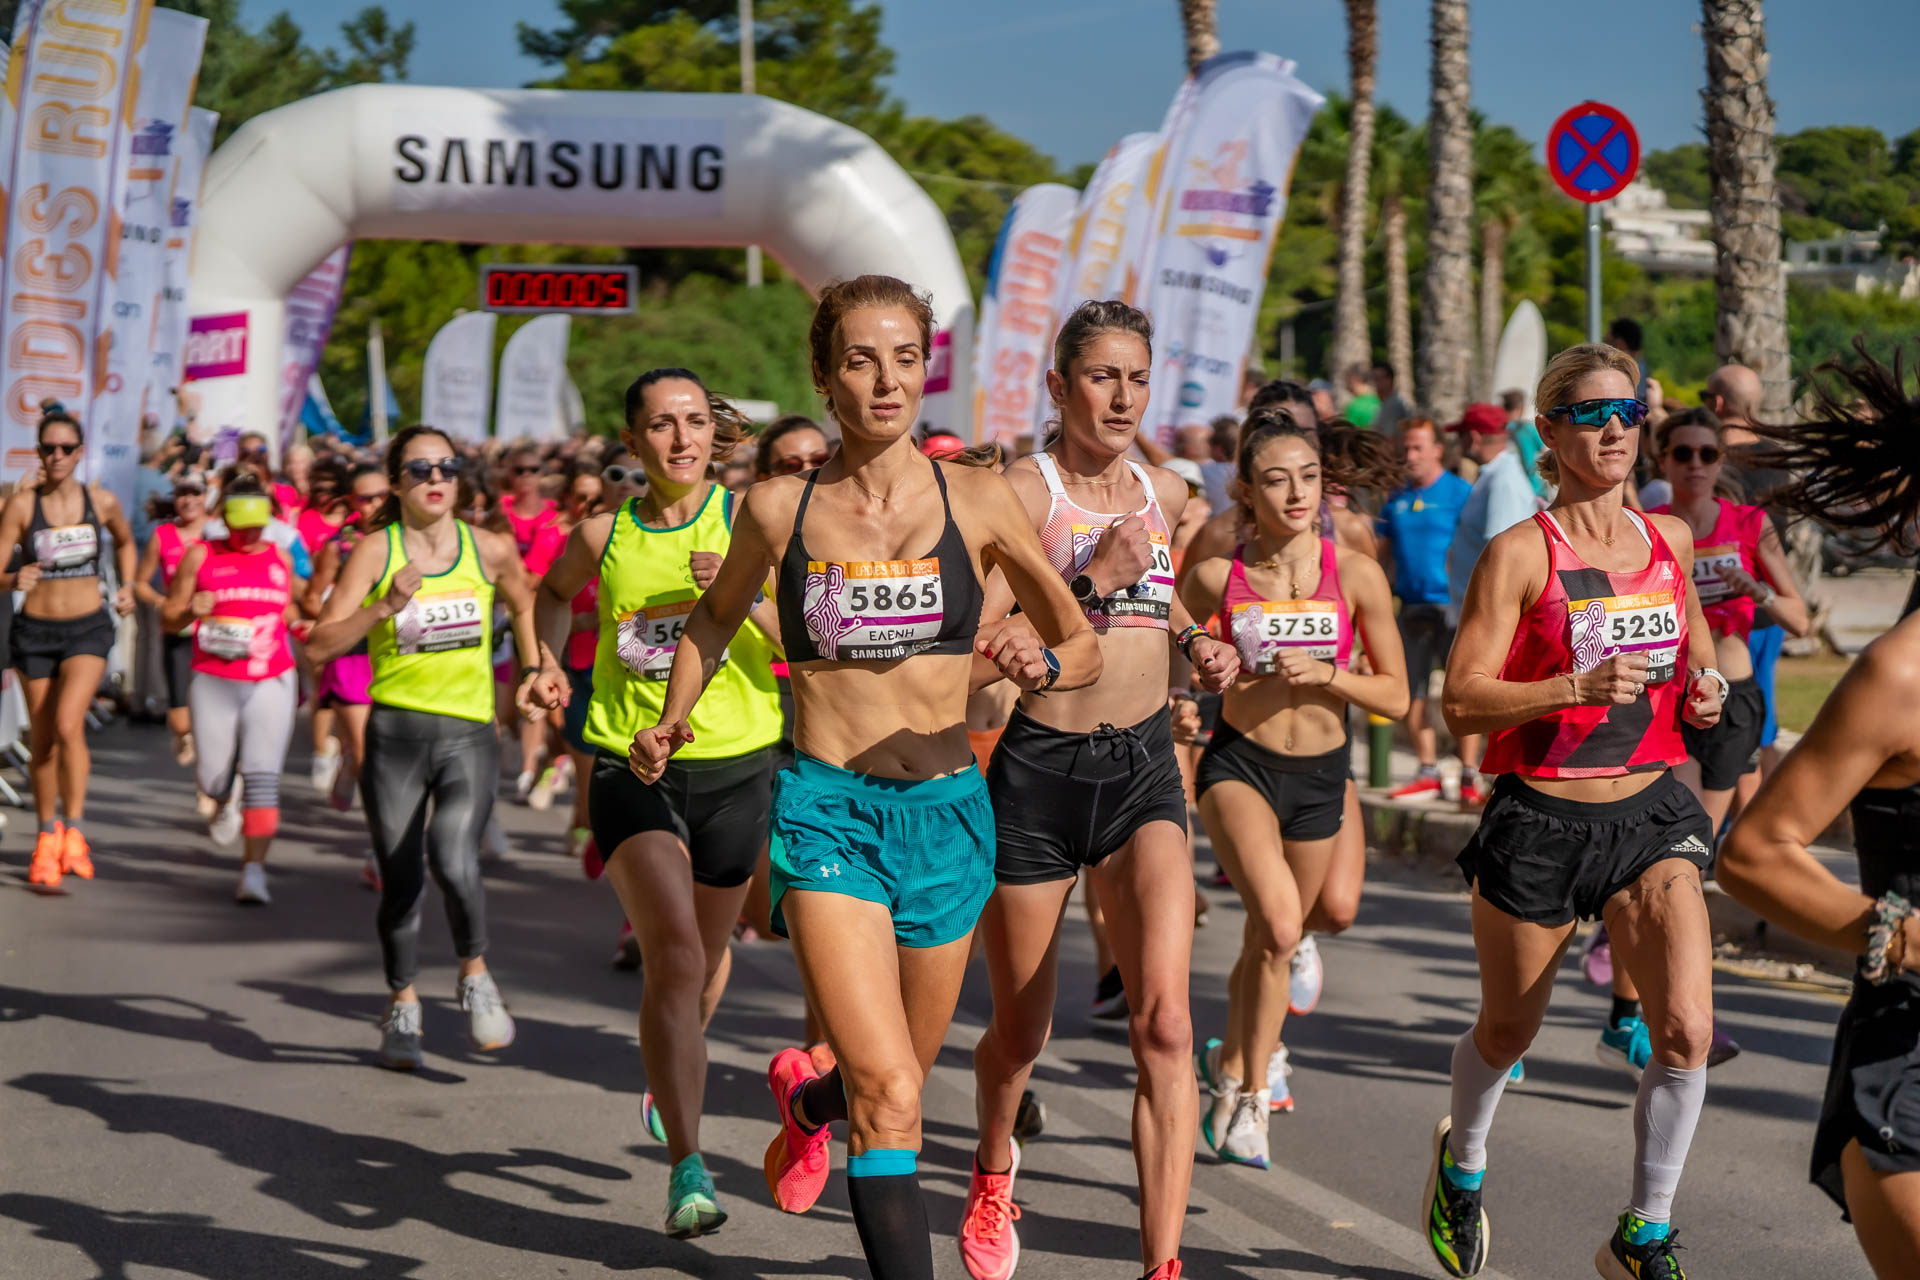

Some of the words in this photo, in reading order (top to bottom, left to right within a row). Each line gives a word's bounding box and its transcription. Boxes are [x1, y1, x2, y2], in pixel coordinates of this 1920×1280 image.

[25, 0, 128, 159] RUN
[394, 135, 725, 192] SAMSUNG
[487, 272, 628, 308] 000005
[187, 327, 246, 366] ART
[856, 564, 888, 577] LADIES
[890, 563, 910, 576] RUN
[850, 582, 938, 612] 5865
[1115, 602, 1156, 613] SAMSUNG
[425, 602, 476, 623] 5319
[654, 621, 683, 644] 56
[1268, 617, 1333, 636] 5758
[1612, 611, 1676, 641] 5236
[851, 645, 905, 659] SAMSUNG
